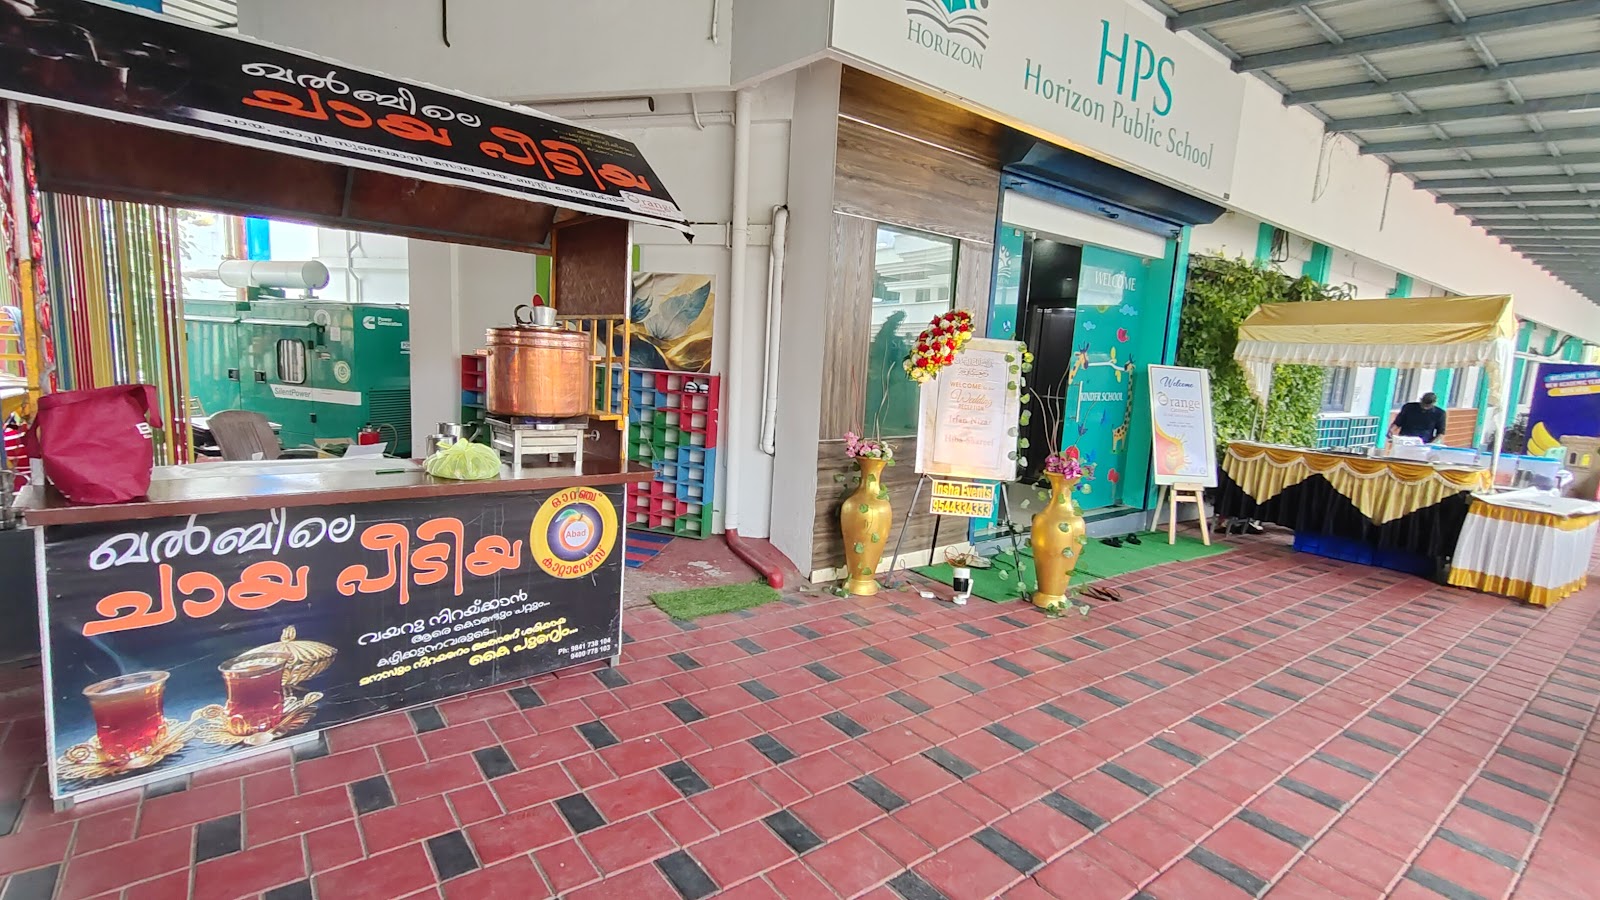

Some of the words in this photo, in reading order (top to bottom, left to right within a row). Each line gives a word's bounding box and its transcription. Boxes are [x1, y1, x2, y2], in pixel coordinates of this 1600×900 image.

[906, 19, 984, 71] HORIZON
[1096, 19, 1176, 117] HPS
[241, 88, 453, 147] ചായ
[1024, 58, 1105, 123] Horizon
[1111, 100, 1162, 148] Public
[1165, 128, 1214, 170] School
[1094, 270, 1137, 292] WELCOME
[949, 381, 982, 390] WELCOME
[1159, 375, 1194, 388] Welcome
[950, 389, 993, 408] Wedding
[1101, 391, 1124, 402] SCHOOL
[934, 481, 961, 496] Insha
[961, 483, 992, 499] Events
[565, 528, 587, 539] Abad
[80, 562, 311, 638] ചായ
